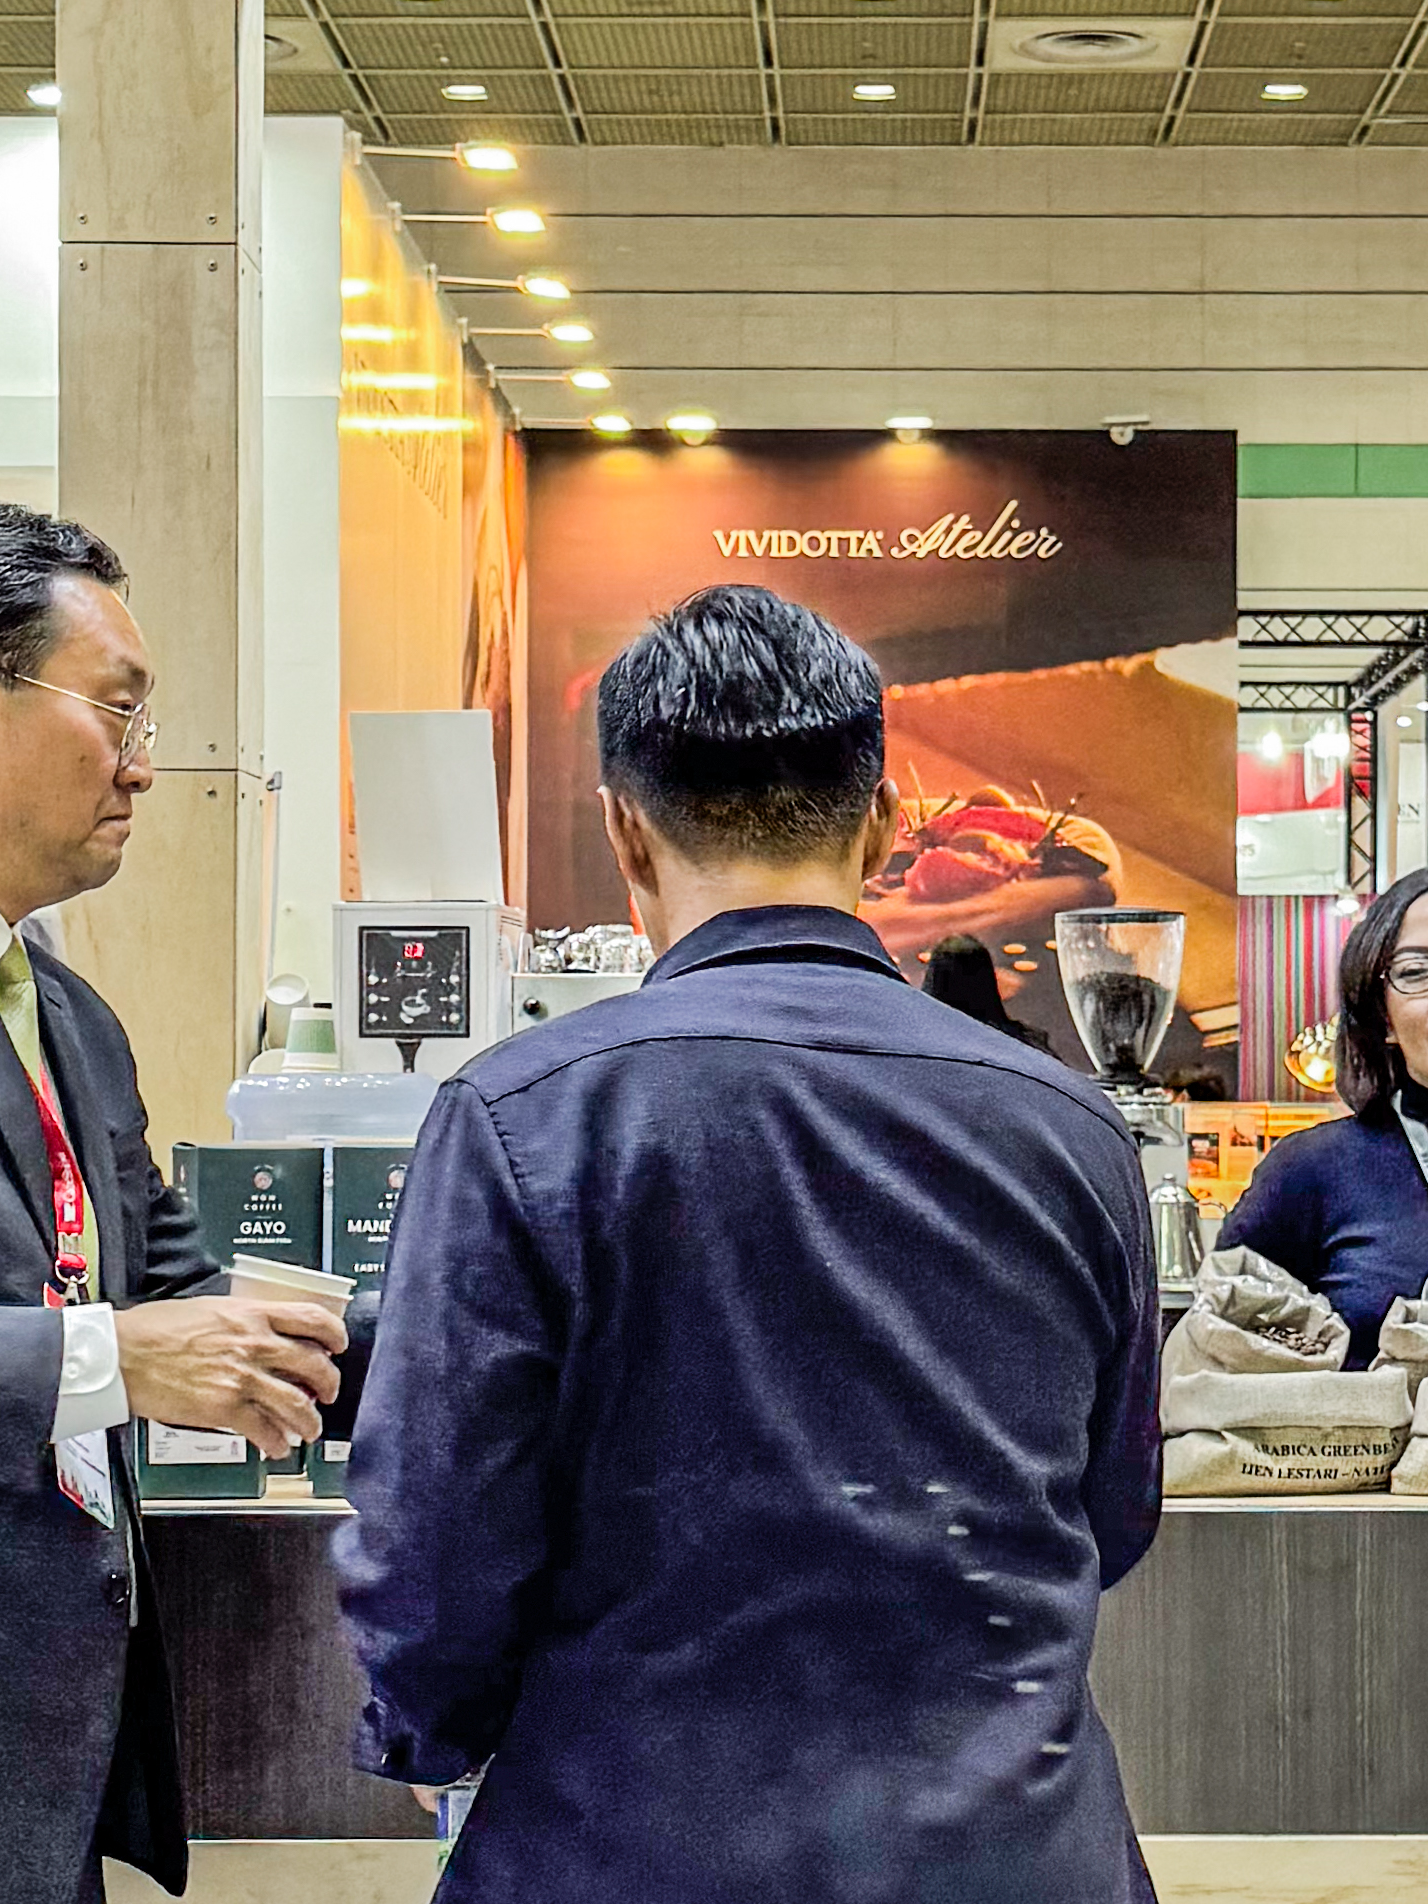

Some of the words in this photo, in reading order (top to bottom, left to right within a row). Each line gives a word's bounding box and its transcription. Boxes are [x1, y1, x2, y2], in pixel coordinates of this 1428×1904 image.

[890, 498, 1063, 560] Atelier
[240, 1221, 286, 1235] GAYO
[1253, 1442, 1317, 1457] ARABICA
[1321, 1443, 1370, 1457] GREEN
[1277, 1467, 1339, 1480] LESTARI
